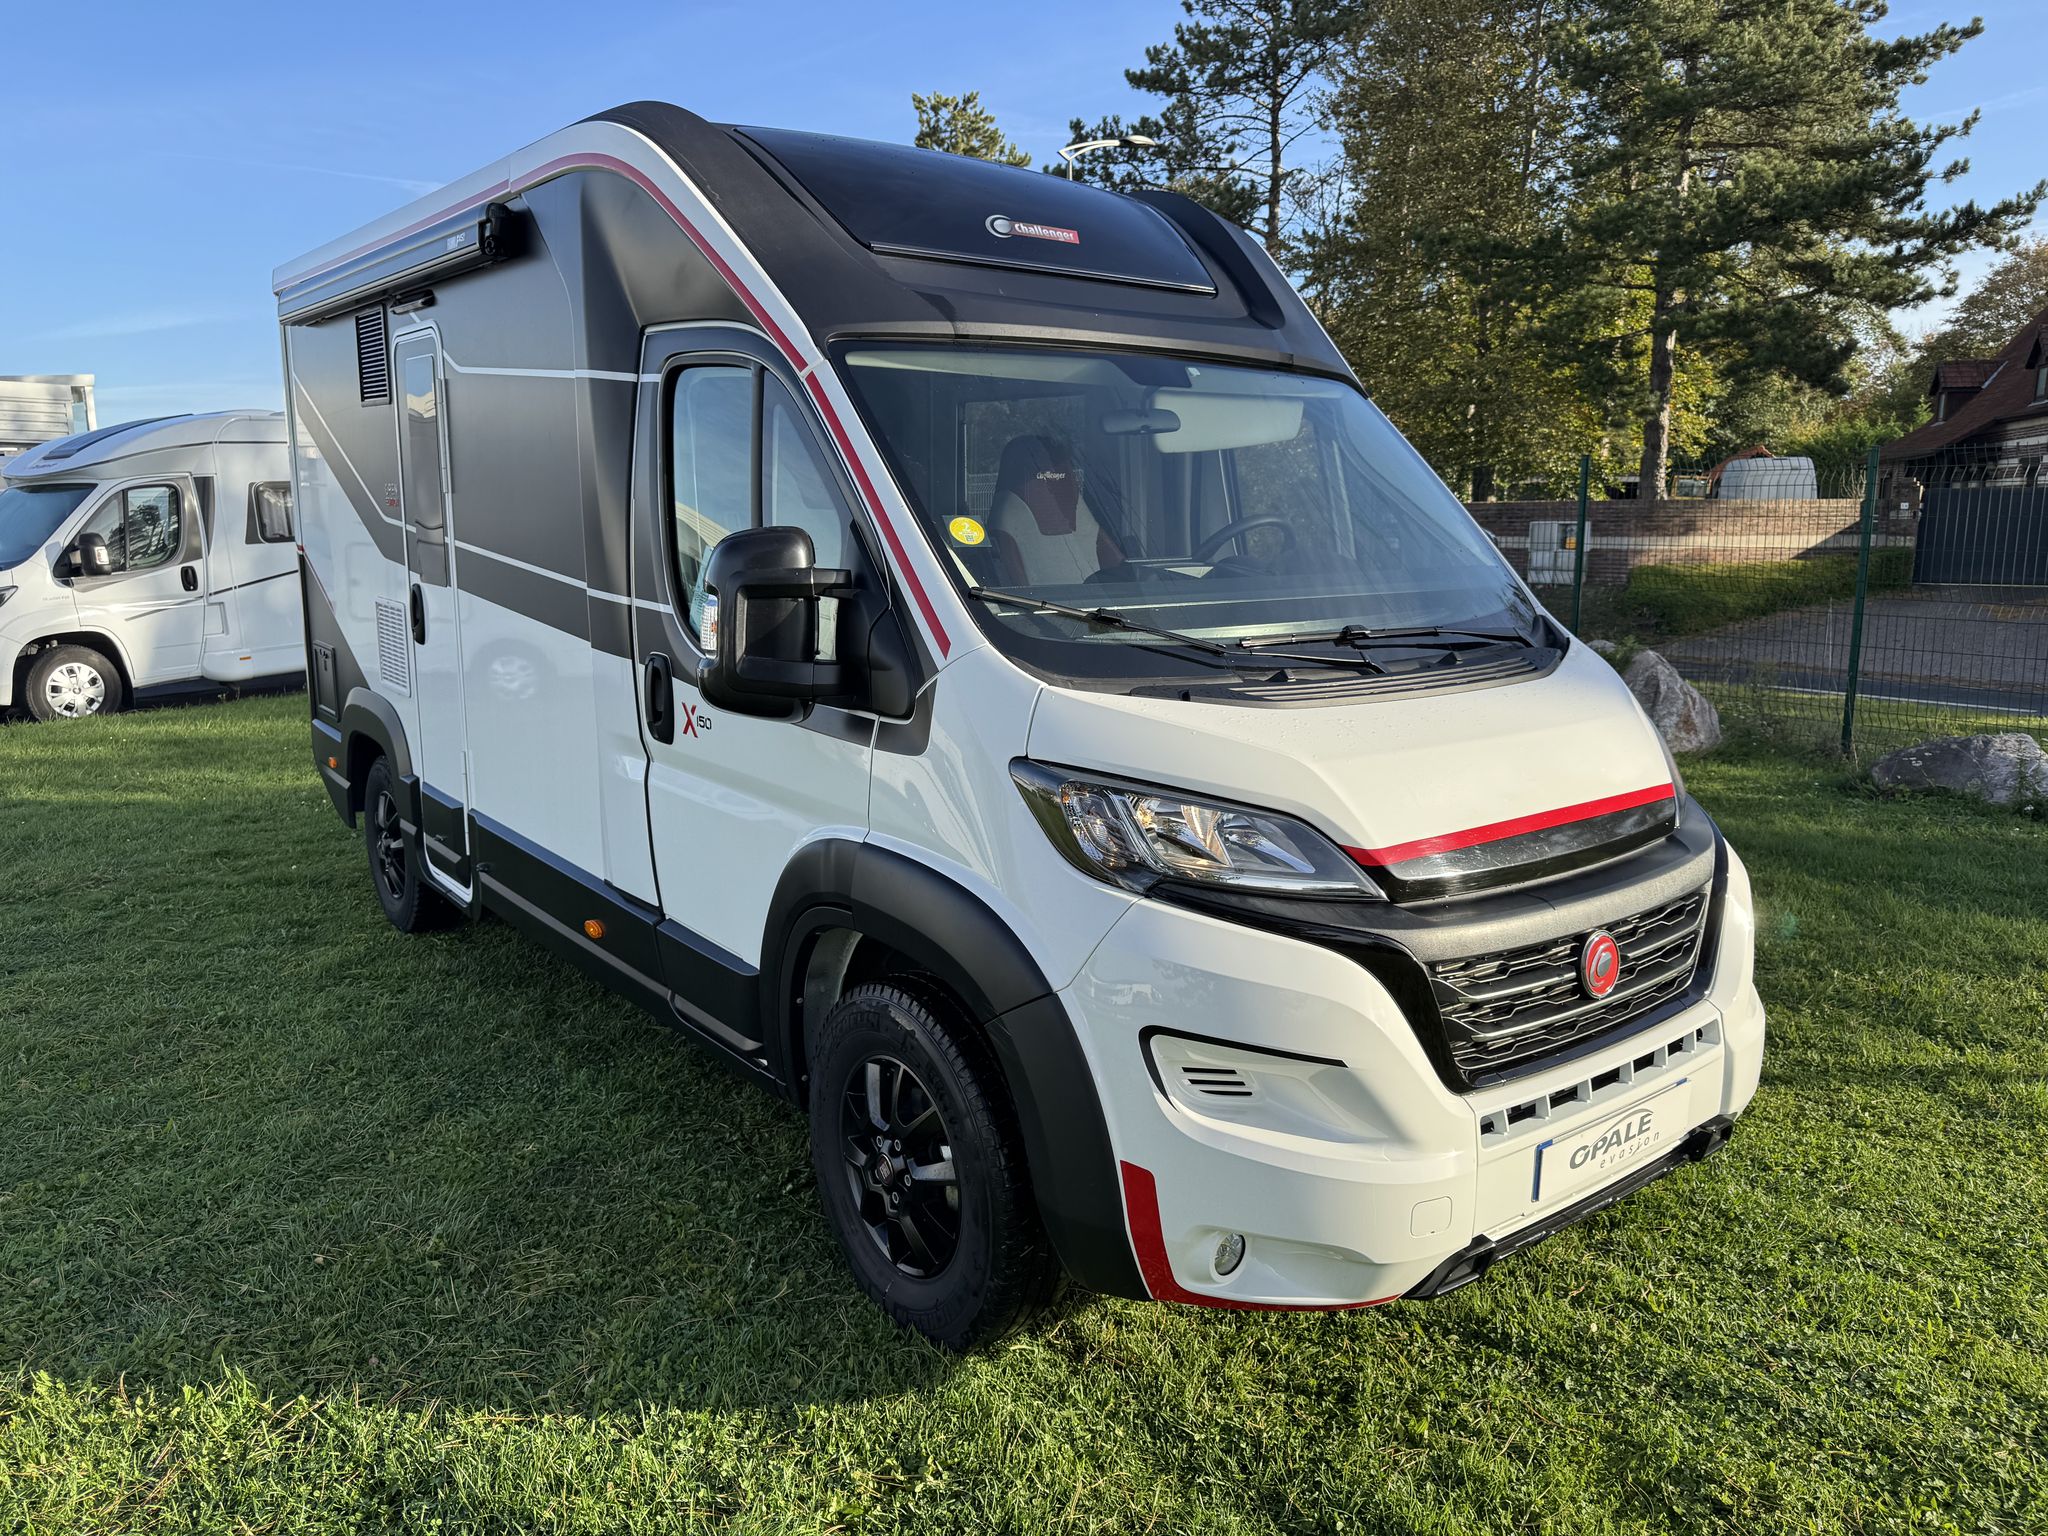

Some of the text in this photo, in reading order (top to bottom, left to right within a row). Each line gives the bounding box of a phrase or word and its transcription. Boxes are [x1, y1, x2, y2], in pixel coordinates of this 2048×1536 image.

[1014, 223, 1075, 241] Challenger
[1569, 1112, 1653, 1169] OPALE
[1600, 1131, 1660, 1168] evasion
